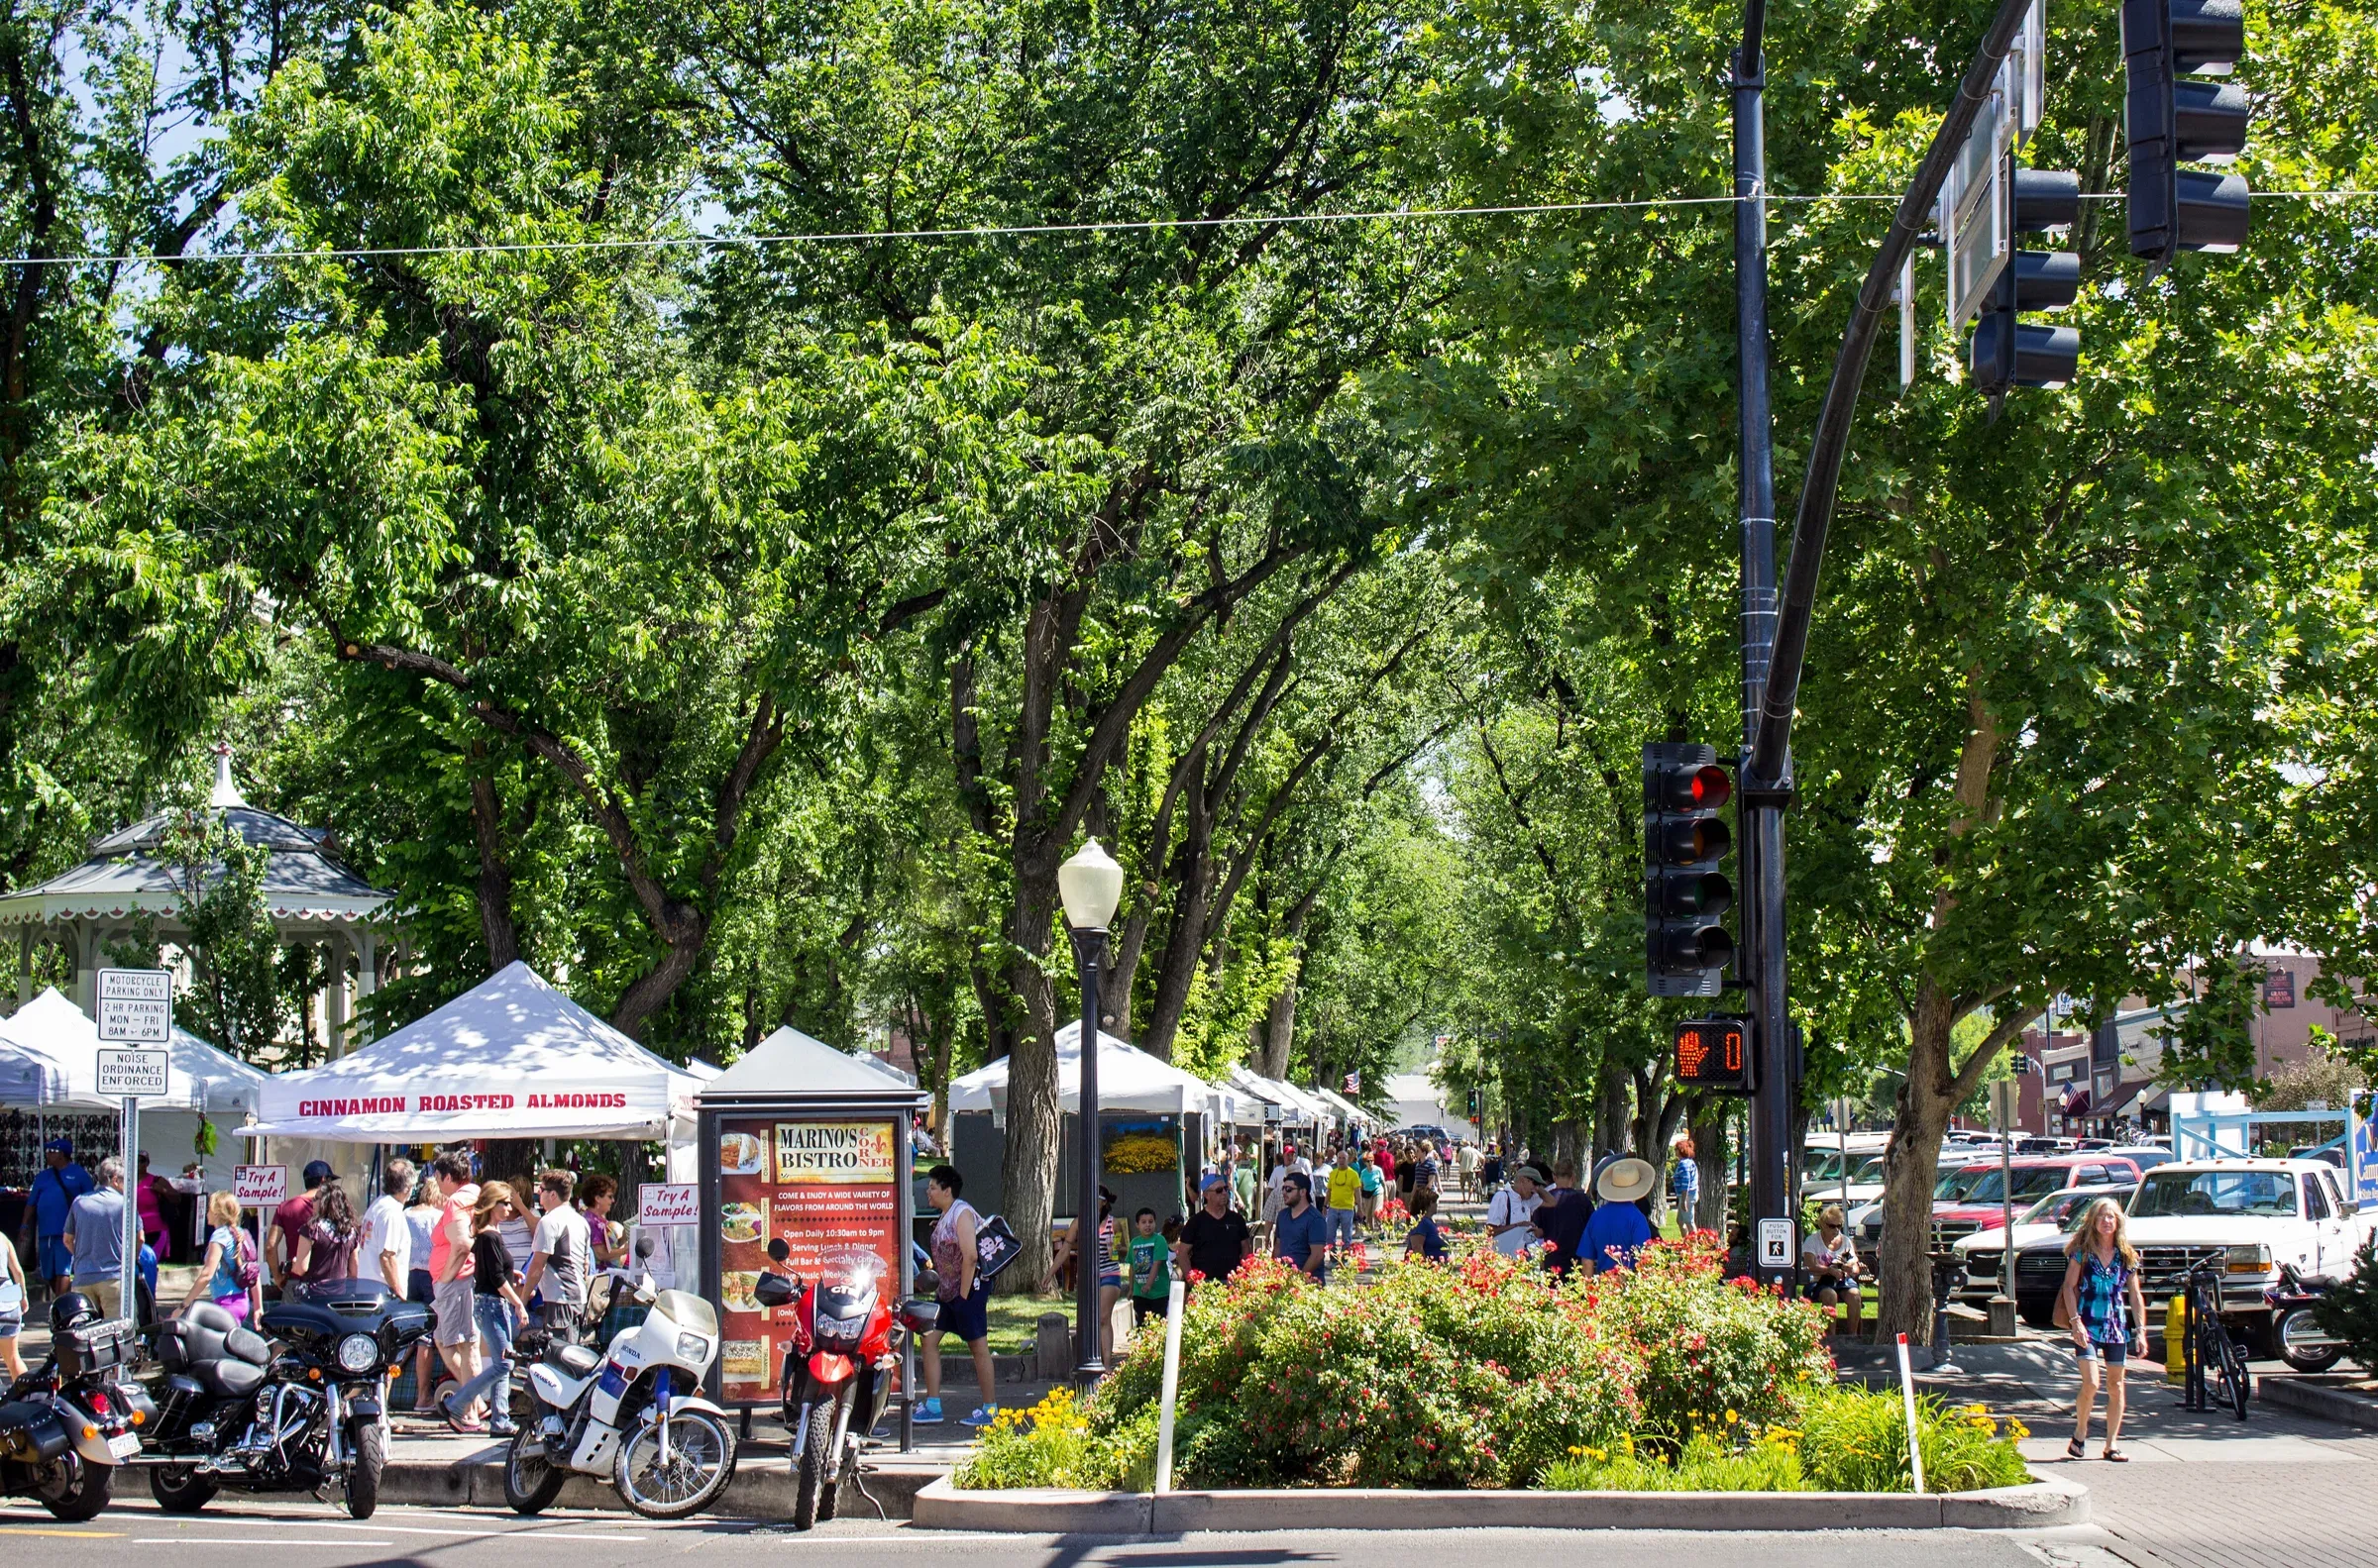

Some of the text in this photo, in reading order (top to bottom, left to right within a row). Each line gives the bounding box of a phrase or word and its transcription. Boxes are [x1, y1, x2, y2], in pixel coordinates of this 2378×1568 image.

[109, 975, 161, 987] MOTORCYCLE
[106, 986, 164, 997] PARKING ONLY
[105, 1003, 164, 1014] 2 HR PARKING
[110, 1015, 130, 1024] MON
[144, 1016, 159, 1025] FRI
[108, 1027, 126, 1036] 8AM
[142, 1028, 160, 1037] 6PM
[1726, 1033, 1741, 1070] 0
[117, 1054, 149, 1064] NOISE
[102, 1065, 162, 1075] ORDINANCE
[102, 1076, 162, 1086] ENFORCED
[299, 1093, 626, 1117] CINNAMON ROASTED ALMONDS
[780, 1128, 857, 1149] MARINO'S
[781, 1152, 858, 1168] BISTRO
[249, 1171, 276, 1186] Try A
[237, 1186, 284, 1202] Sample!
[657, 1189, 690, 1204] Try A
[778, 1192, 799, 1200] COME
[800, 1192, 806, 1200] &
[807, 1192, 827, 1200] ENJOY
[828, 1191, 833, 1200] A
[834, 1191, 851, 1199] WIDE
[852, 1191, 881, 1199] VARIETY
[644, 1204, 698, 1220] Sample!
[869, 1202, 893, 1210] WORLD
[784, 1230, 803, 1239] Open
[805, 1229, 824, 1238] Daily
[868, 1229, 885, 1238] 9pm
[792, 1244, 819, 1252] Serving
[821, 1243, 842, 1252] Lunch
[852, 1243, 877, 1251] Dinner
[786, 1258, 799, 1266] Full
[814, 1257, 821, 1266] &
[823, 1254, 855, 1265] Specialty
[621, 1345, 641, 1360] HONDA
[533, 1371, 557, 1389] TRANSALP
